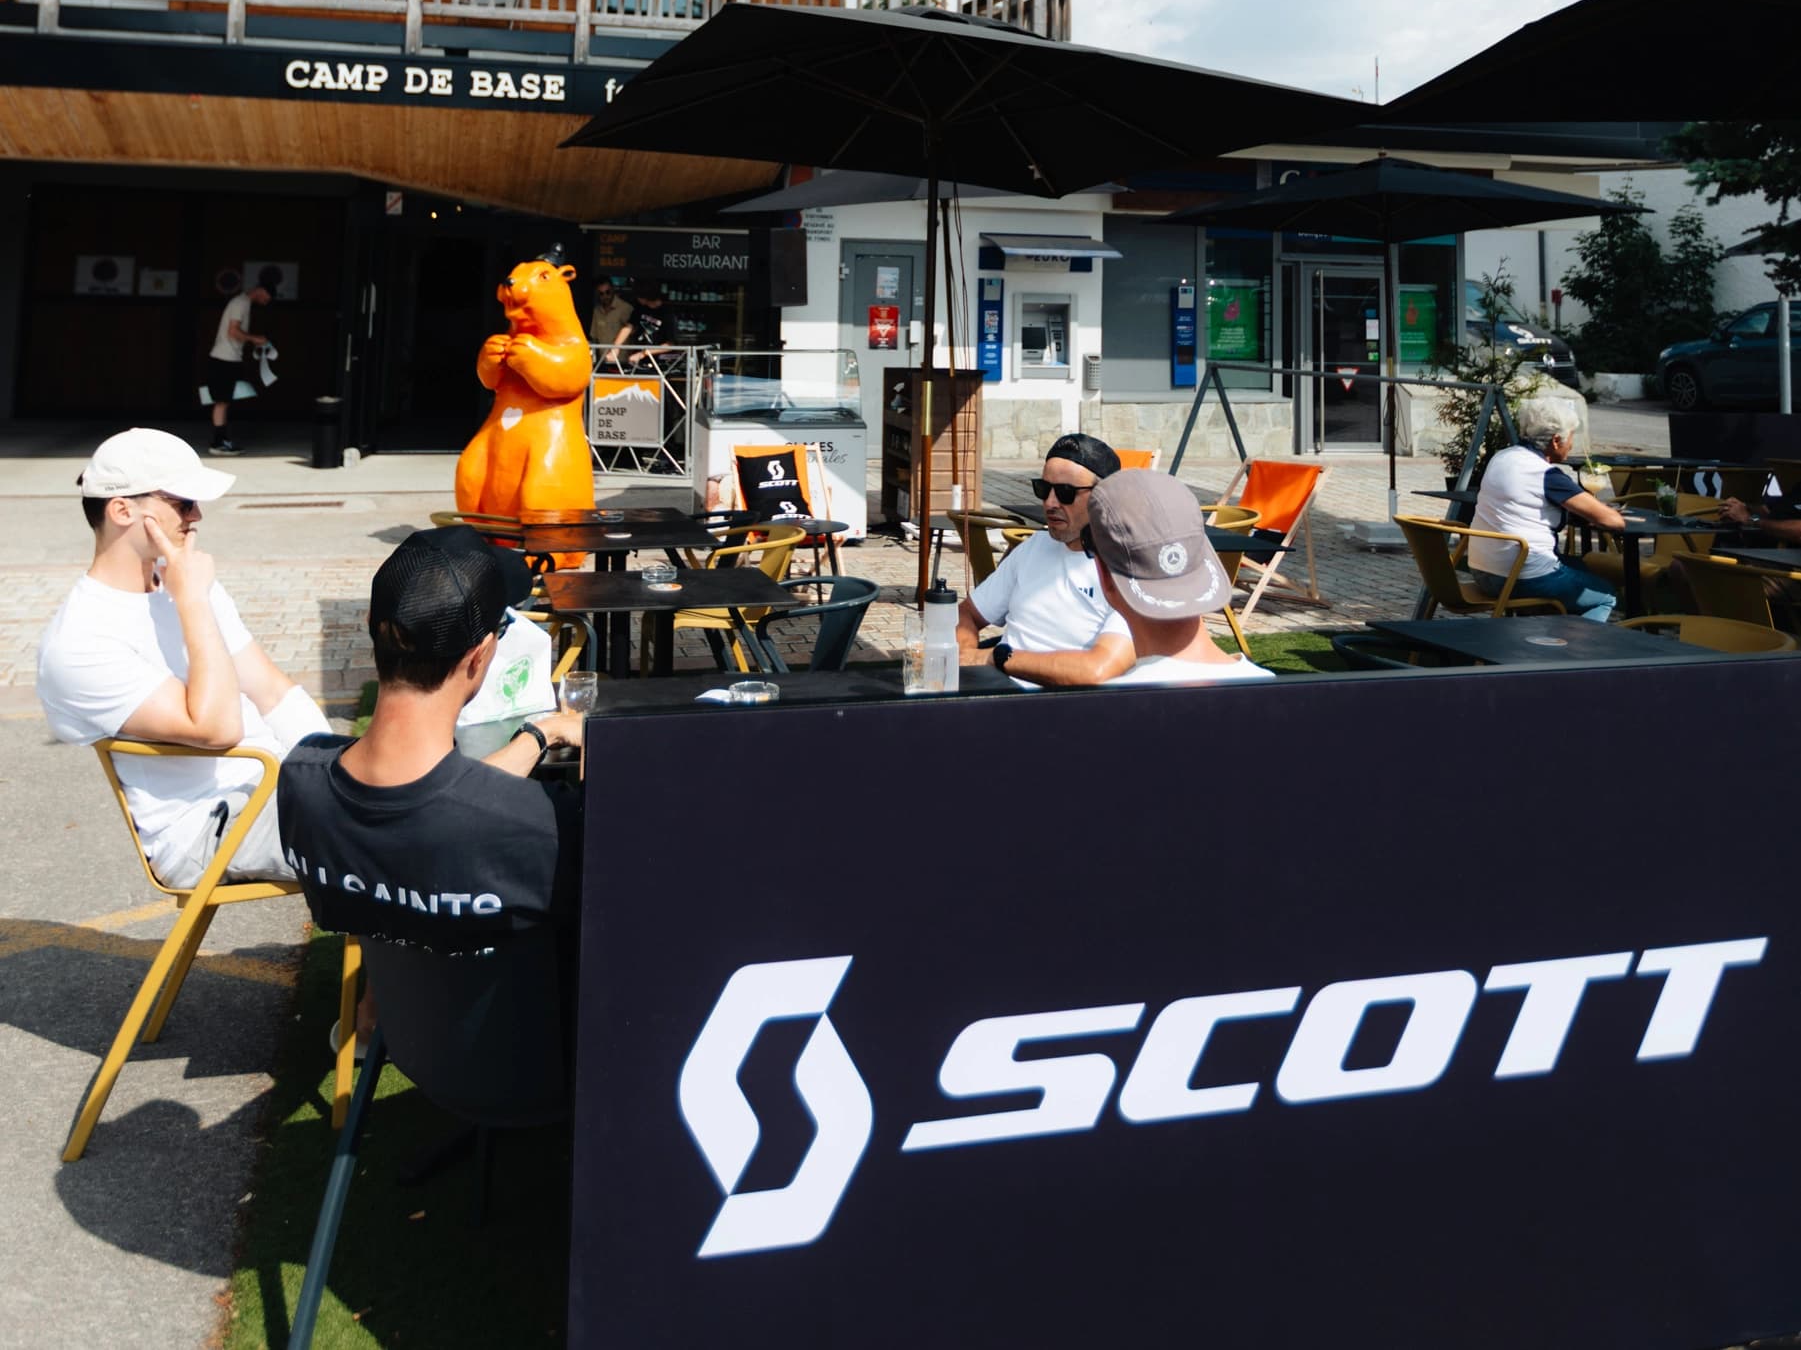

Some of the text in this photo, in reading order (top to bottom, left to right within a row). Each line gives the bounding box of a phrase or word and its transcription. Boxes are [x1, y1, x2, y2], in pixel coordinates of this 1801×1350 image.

[285, 60, 566, 101] CAMP DE BASE
[692, 234, 721, 250] BAR
[662, 253, 749, 270] RESTAURANT
[597, 407, 627, 417] CAMP
[598, 419, 613, 428] DE
[597, 431, 627, 440] BASE
[757, 479, 799, 489] SCOTT
[900, 936, 1769, 1153] SCOTT
